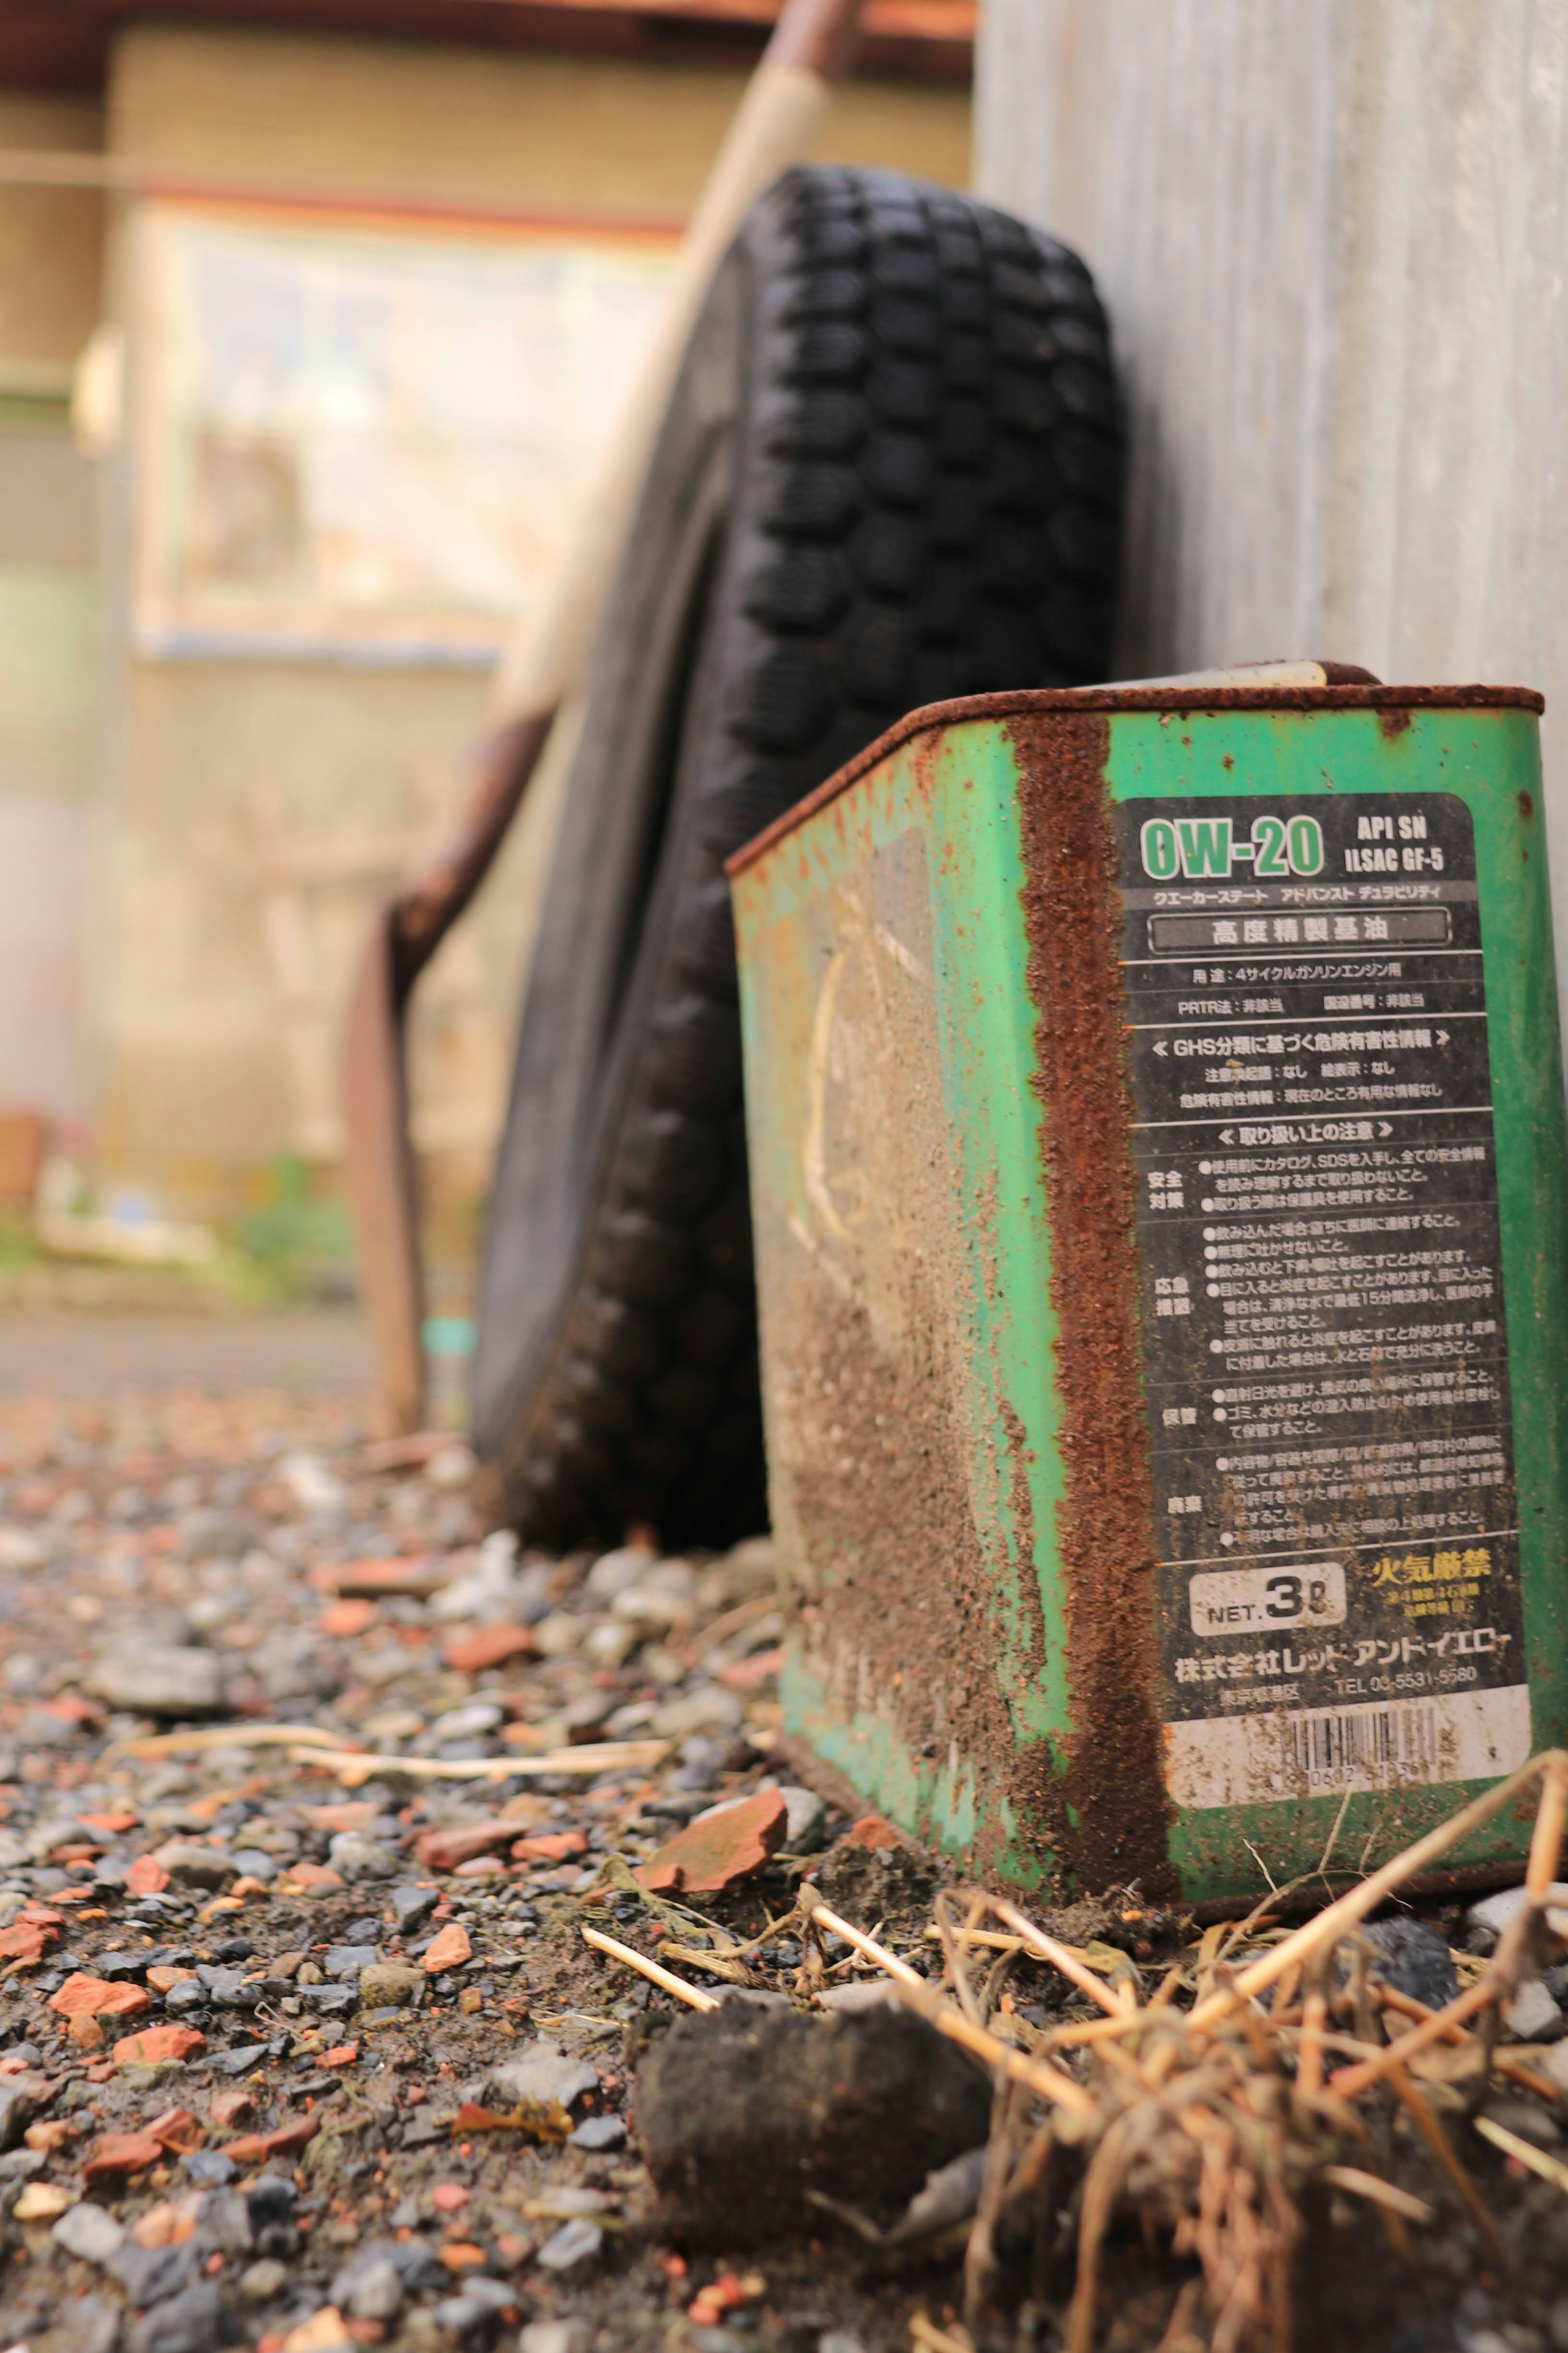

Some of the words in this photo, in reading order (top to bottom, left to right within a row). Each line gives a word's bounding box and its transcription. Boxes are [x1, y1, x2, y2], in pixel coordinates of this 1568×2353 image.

[1357, 816, 1393, 840] API
[1397, 815, 1427, 840] SN
[1140, 815, 1324, 880] 0W-20
[1344, 847, 1398, 872] ILSAC
[1402, 847, 1444, 871] GF-5
[1154, 889, 1268, 906] クエーカーステート
[1281, 885, 1354, 902] アドバンスト
[1359, 884, 1441, 900] デュラビリティ
[1212, 915, 1389, 945] 高度精製基油
[1372, 1547, 1492, 1587] 火気厳禁
[1335, 1677, 1368, 1695] TEL
